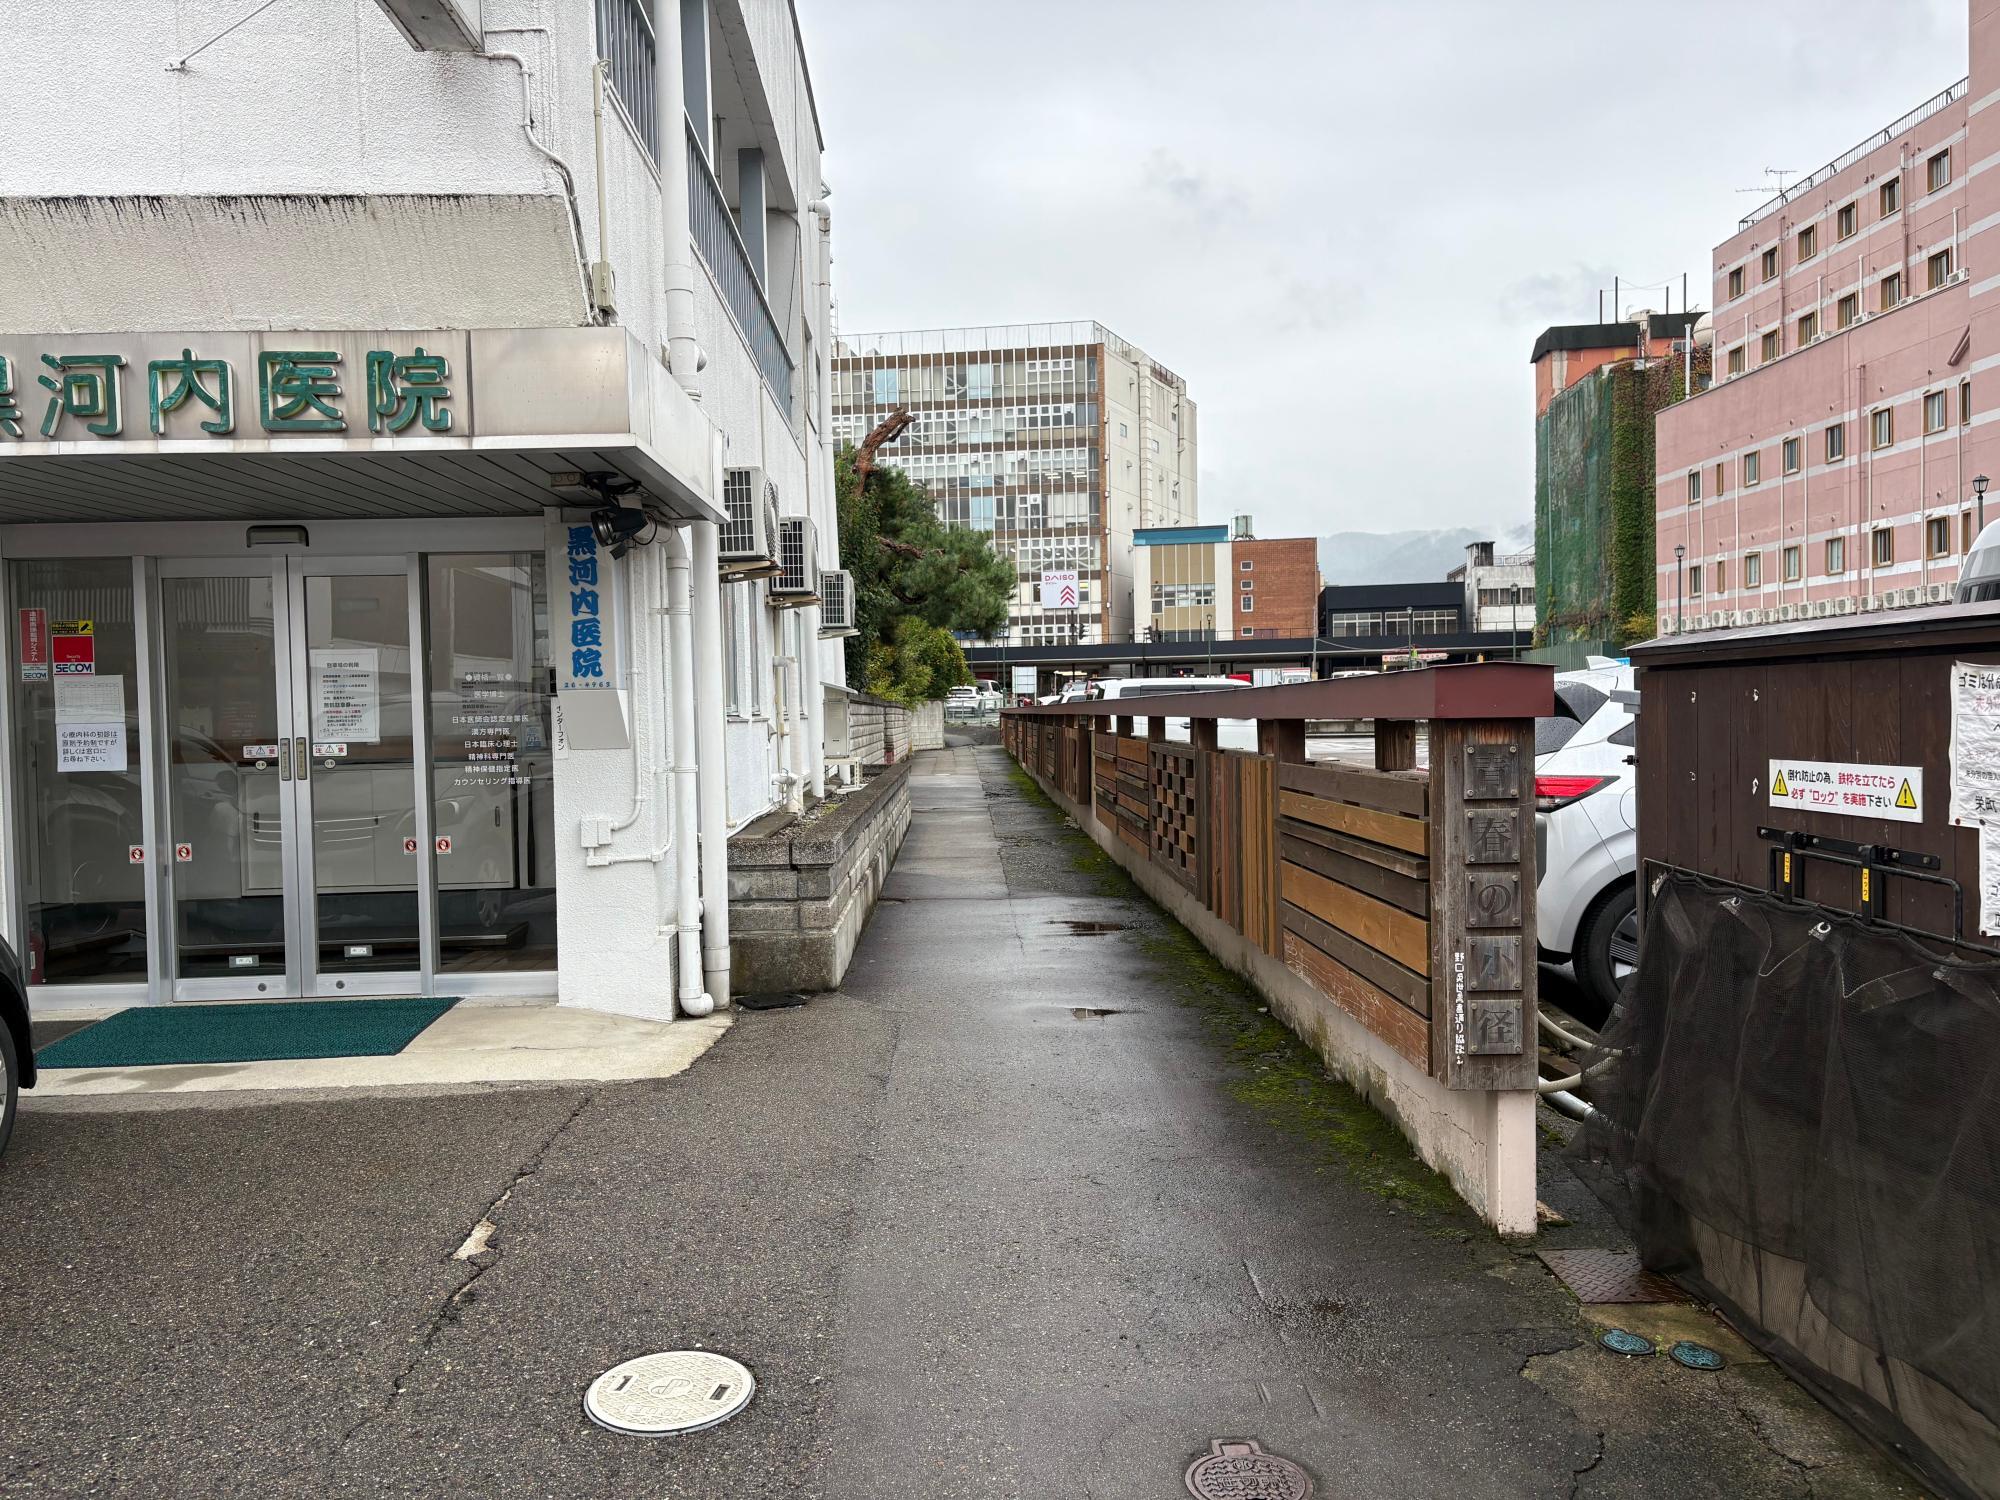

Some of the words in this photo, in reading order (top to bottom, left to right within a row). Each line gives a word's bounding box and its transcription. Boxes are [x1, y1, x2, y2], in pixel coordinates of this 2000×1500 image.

[0, 347, 454, 437] 河内医院
[567, 525, 604, 679] 黒河内医院
[56, 664, 92, 672] SECOM
[62, 731, 118, 739] 心療内科の初診は
